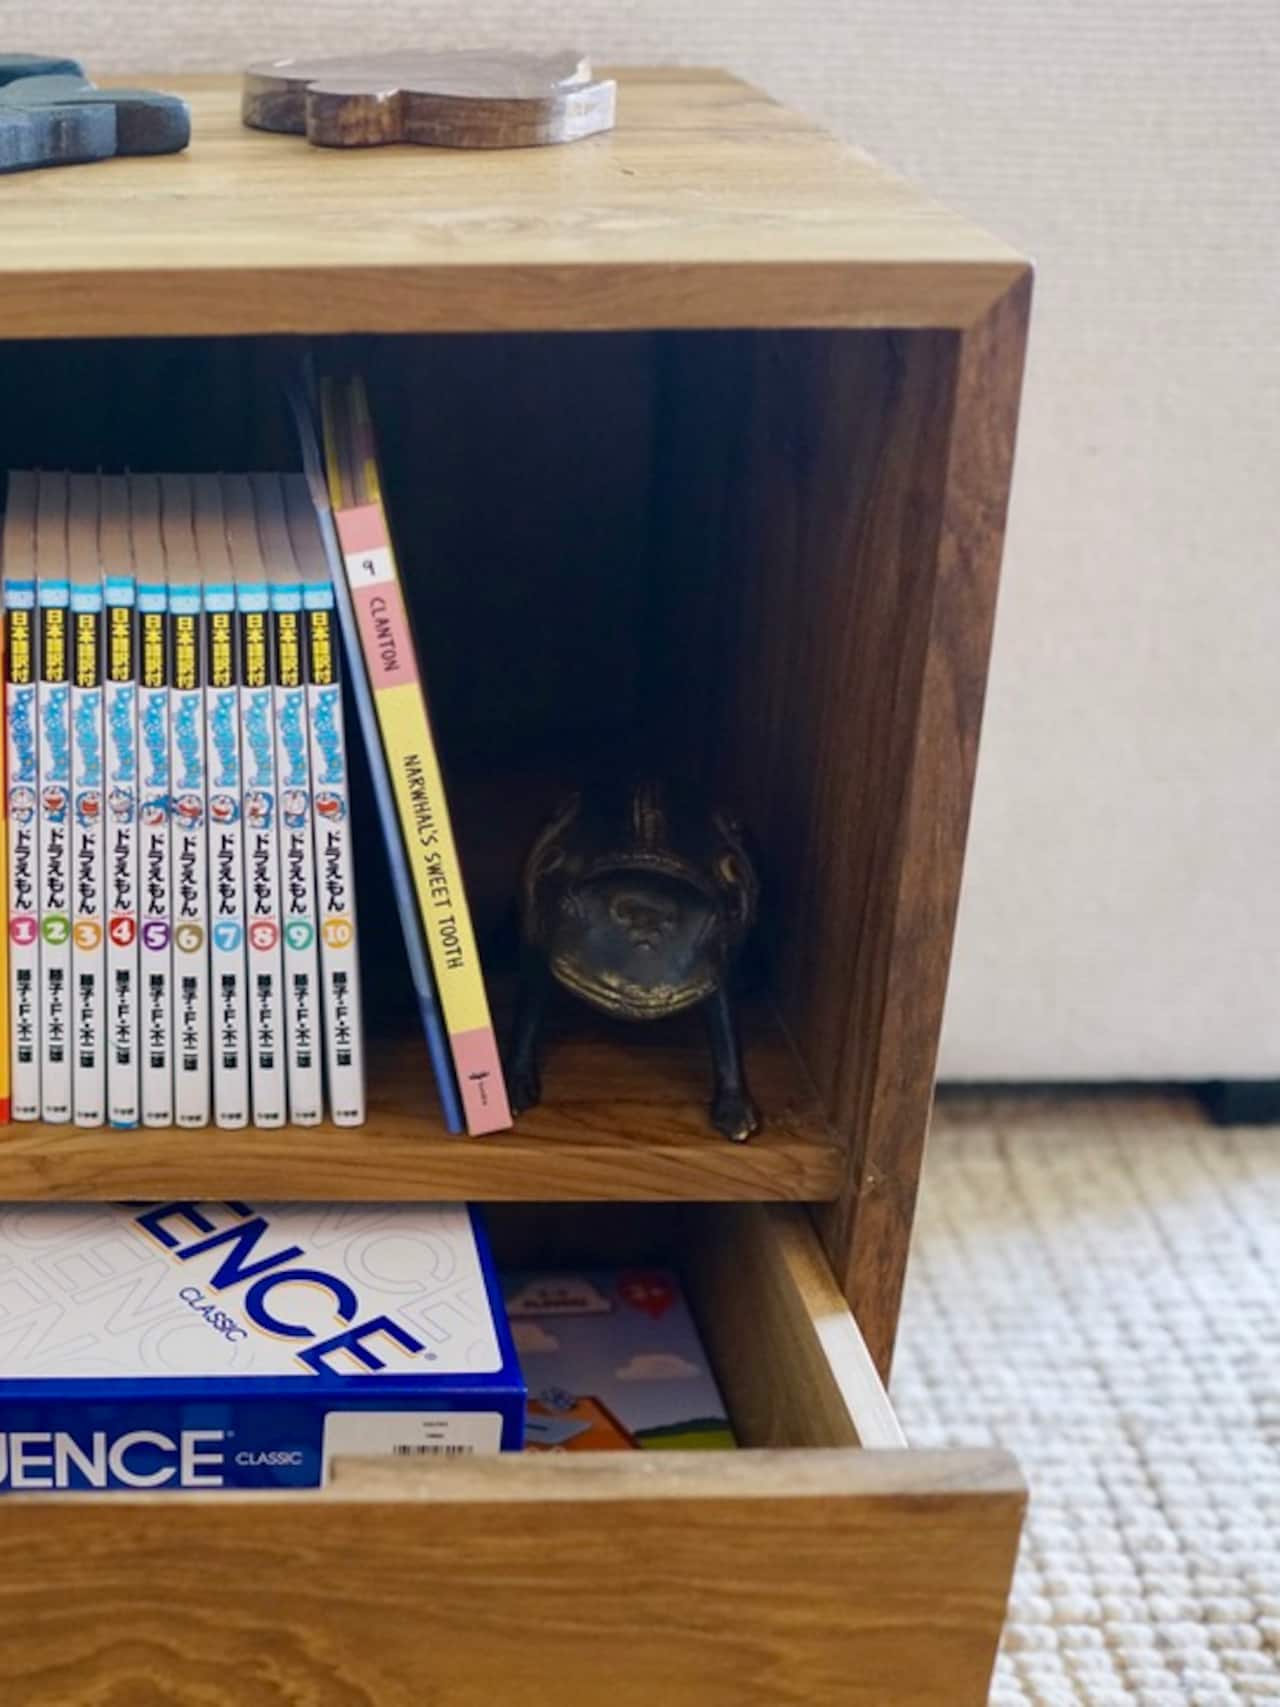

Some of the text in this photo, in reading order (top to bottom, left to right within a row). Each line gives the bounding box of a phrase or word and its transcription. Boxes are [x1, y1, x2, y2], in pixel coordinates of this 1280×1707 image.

[367, 595, 400, 673] CLANTON
[16, 829, 32, 910] ドラえもん
[47, 828, 64, 909] ドラえもん
[79, 833, 96, 915] ドラえもん
[114, 829, 131, 910] ドラえもん
[148, 834, 165, 915] ドラえもん
[181, 836, 198, 917] ドラえもん
[218, 833, 236, 915] ドラえもん
[254, 833, 272, 915] ドラえもん
[289, 833, 307, 914] ドラえもん
[326, 831, 346, 912] ドラえもん
[402, 753, 463, 970] NARWHAL'S SWEET TOOTH
[178, 1286, 248, 1343] CLASSIC
[235, 1451, 303, 1467] CLASSIC
